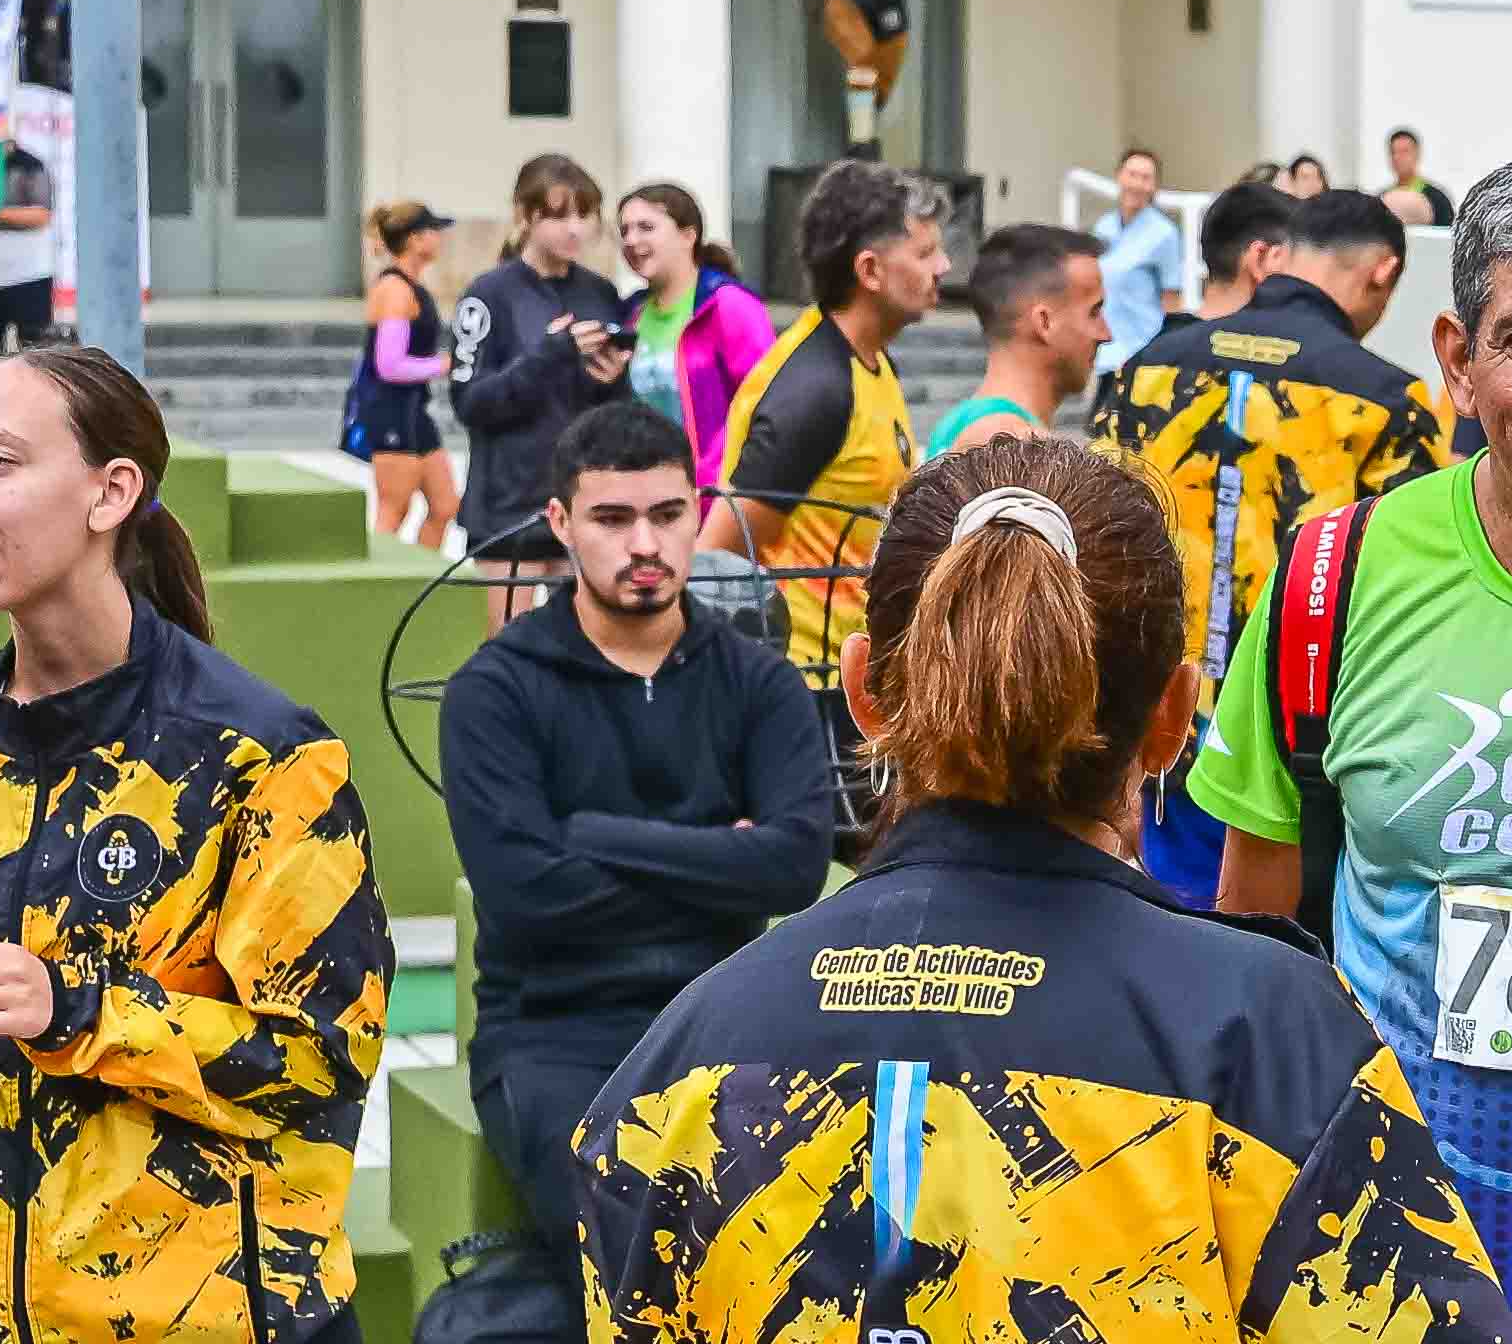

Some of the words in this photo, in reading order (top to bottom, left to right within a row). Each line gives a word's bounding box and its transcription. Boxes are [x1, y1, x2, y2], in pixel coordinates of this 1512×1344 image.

[1308, 520, 1338, 617] AMIGOS!
[816, 951, 878, 975] Centro
[883, 948, 910, 973] de
[913, 949, 1040, 981] Actividades
[825, 979, 916, 1006] Atléticas
[919, 981, 960, 1007] Bell
[963, 982, 1010, 1011] Ville
